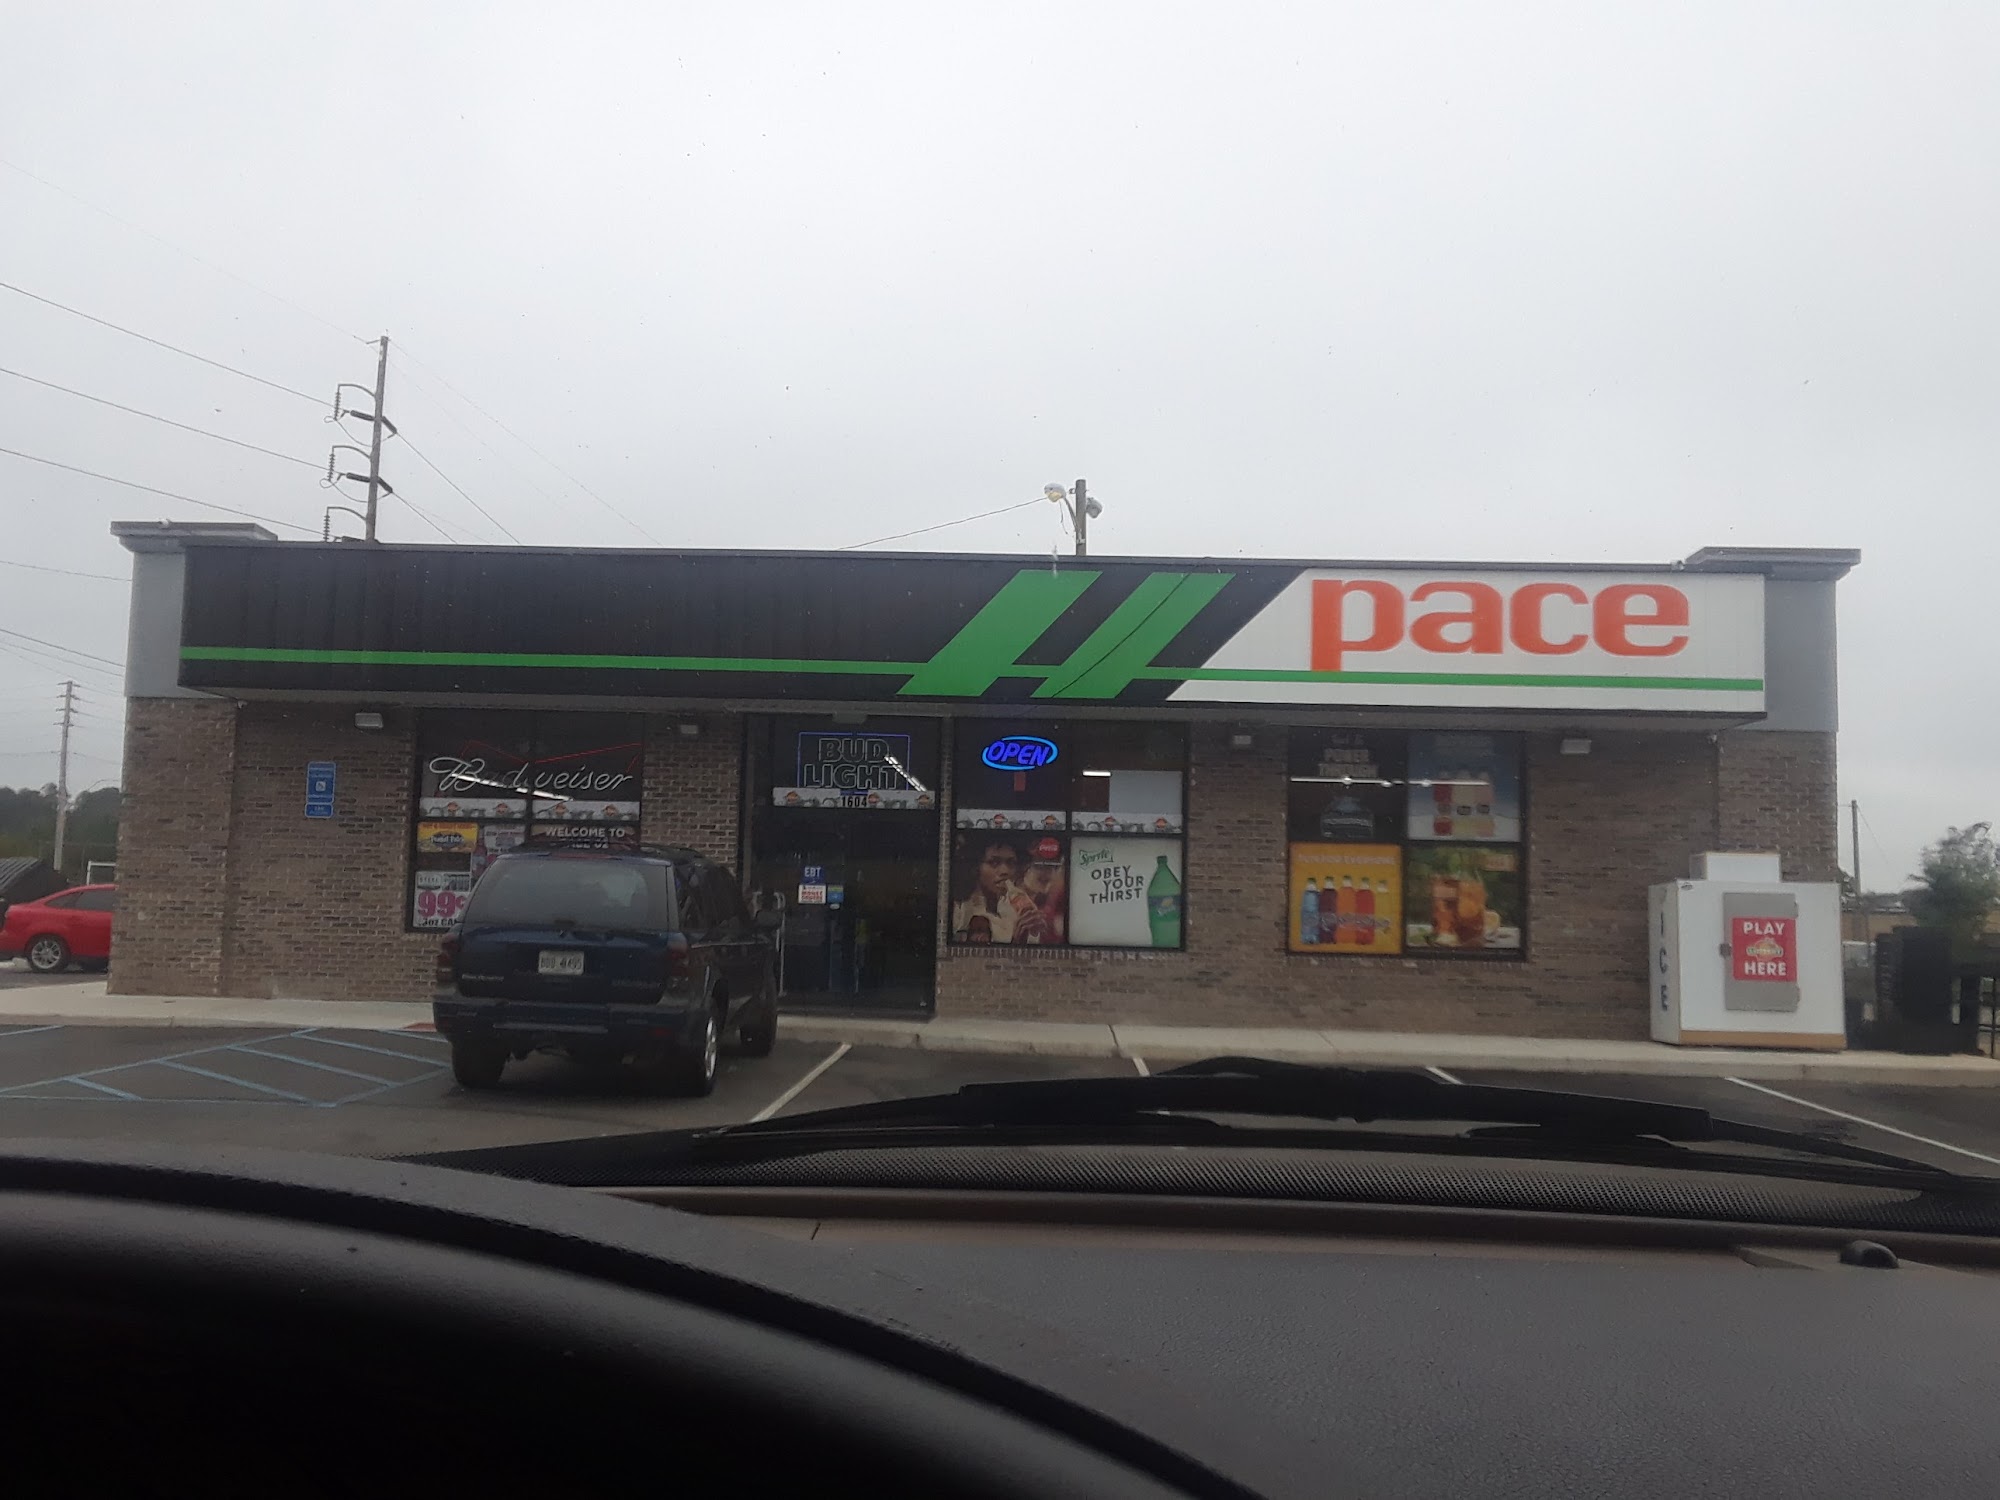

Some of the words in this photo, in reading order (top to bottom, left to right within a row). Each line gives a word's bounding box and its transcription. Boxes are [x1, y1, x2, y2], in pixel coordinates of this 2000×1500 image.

[1311, 578, 1690, 671] pace
[818, 737, 890, 763] BUD
[987, 740, 1050, 767] OPEN
[803, 763, 899, 790] LIGHT
[841, 795, 868, 808] 1604
[545, 827, 606, 837] WELCOME
[608, 828, 625, 838] TO
[804, 866, 822, 878] EBT
[1091, 865, 1131, 880] OBEY
[1103, 876, 1144, 891] YOUR
[1089, 888, 1143, 904] THIRST
[1743, 921, 1785, 936] PLAY
[1660, 911, 1669, 1012] ICE
[1744, 961, 1787, 976] HERE
